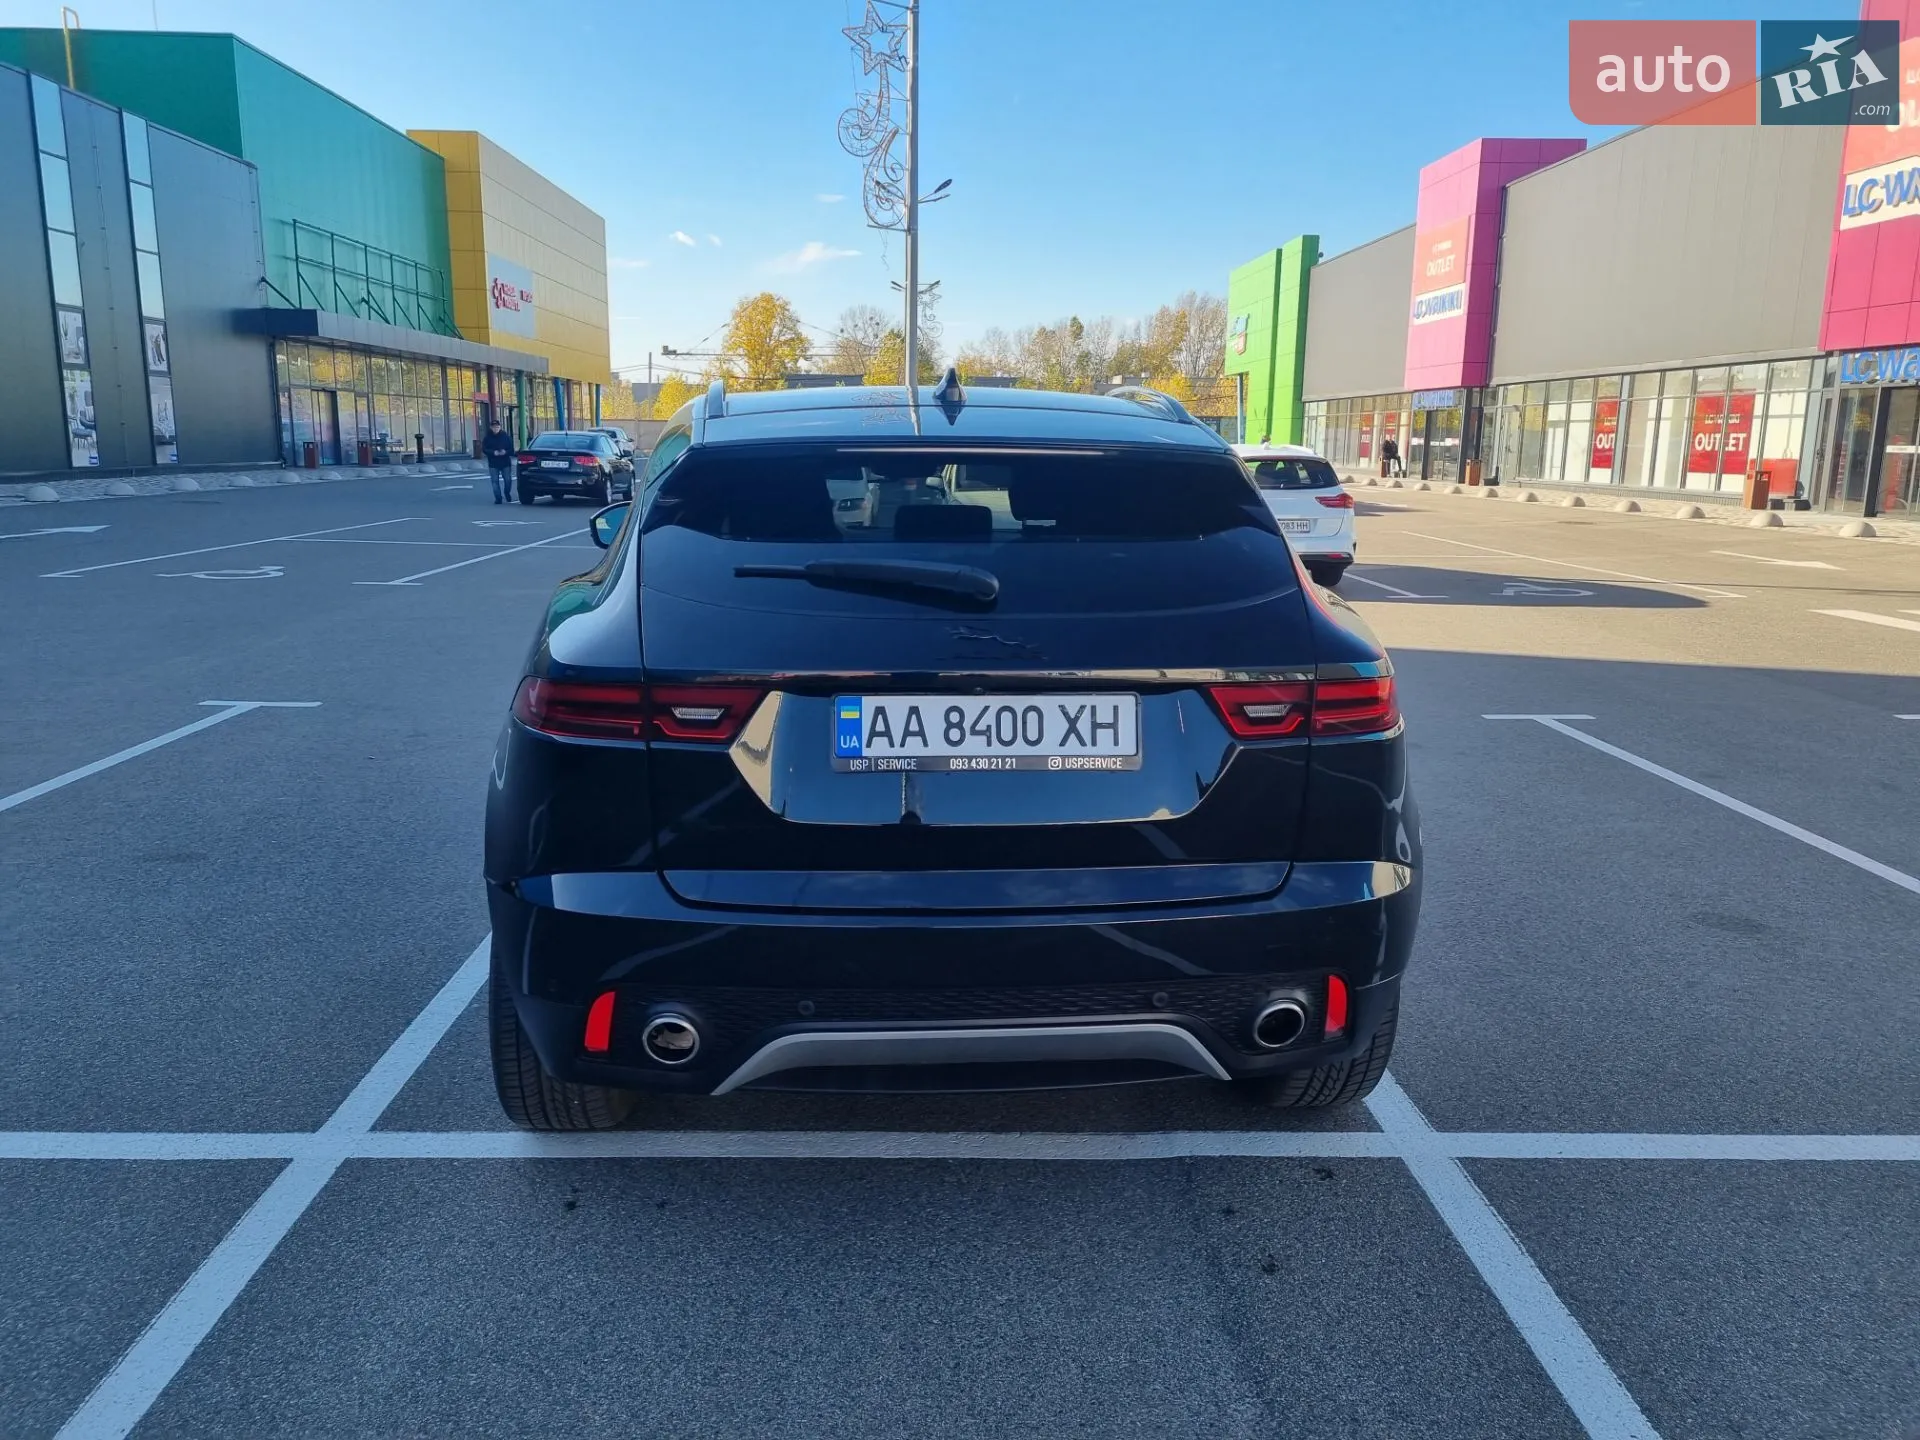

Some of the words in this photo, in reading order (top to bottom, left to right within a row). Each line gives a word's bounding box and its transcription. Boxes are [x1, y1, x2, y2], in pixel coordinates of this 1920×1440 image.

[1695, 433, 1747, 451] OUTET
[866, 705, 929, 749] AA
[943, 704, 1045, 749] 8400
[1058, 704, 1120, 748] XH
[840, 736, 859, 749] UA
[850, 759, 869, 771] USP
[877, 758, 917, 770] SERVICE
[950, 758, 969, 769] 093
[970, 758, 989, 769] 430
[991, 758, 1003, 769] 21
[1005, 758, 1017, 769] 21
[1064, 757, 1123, 769] USPSERVICE
